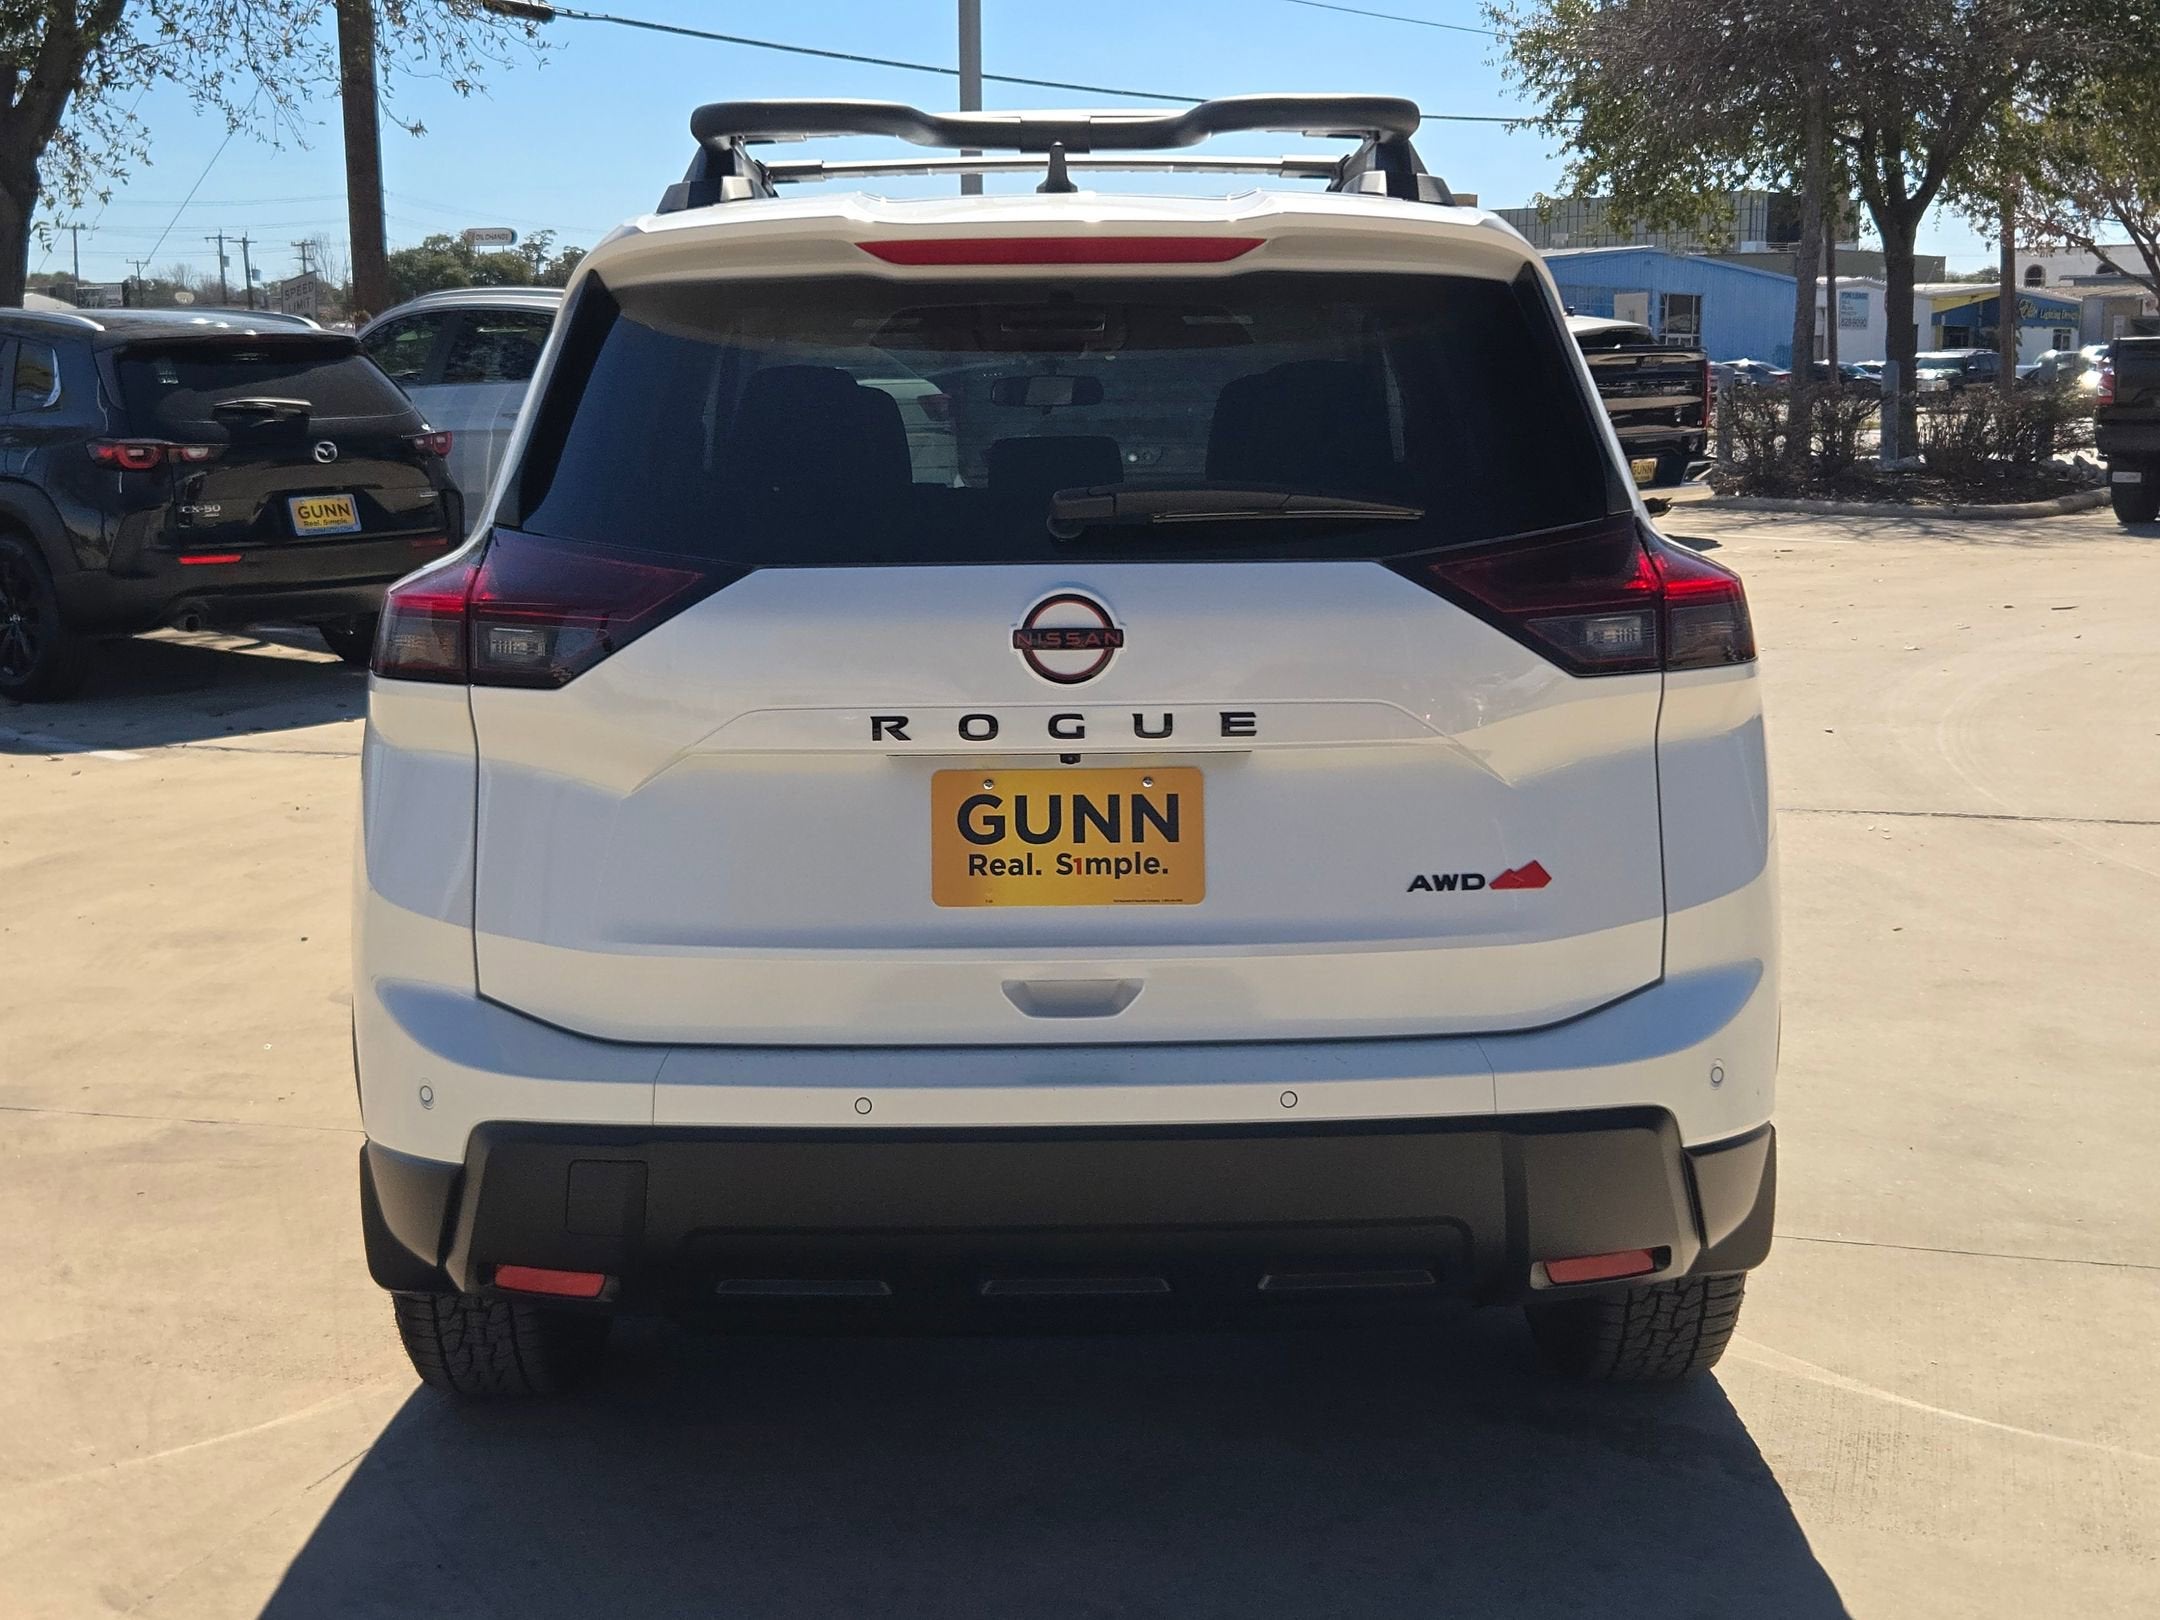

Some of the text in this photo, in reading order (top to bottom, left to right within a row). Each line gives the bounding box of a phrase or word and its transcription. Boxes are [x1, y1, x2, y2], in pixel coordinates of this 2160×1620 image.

[285, 281, 314, 300] SPEED
[288, 297, 311, 313] LIMIT
[182, 504, 221, 514] CX-50
[297, 503, 351, 519] GUNN
[1015, 630, 1122, 648] NISSAN
[870, 711, 1258, 742] ROGUE
[957, 793, 1180, 845] GUNN
[968, 852, 1042, 876] Real.
[1406, 872, 1486, 893] AWD
